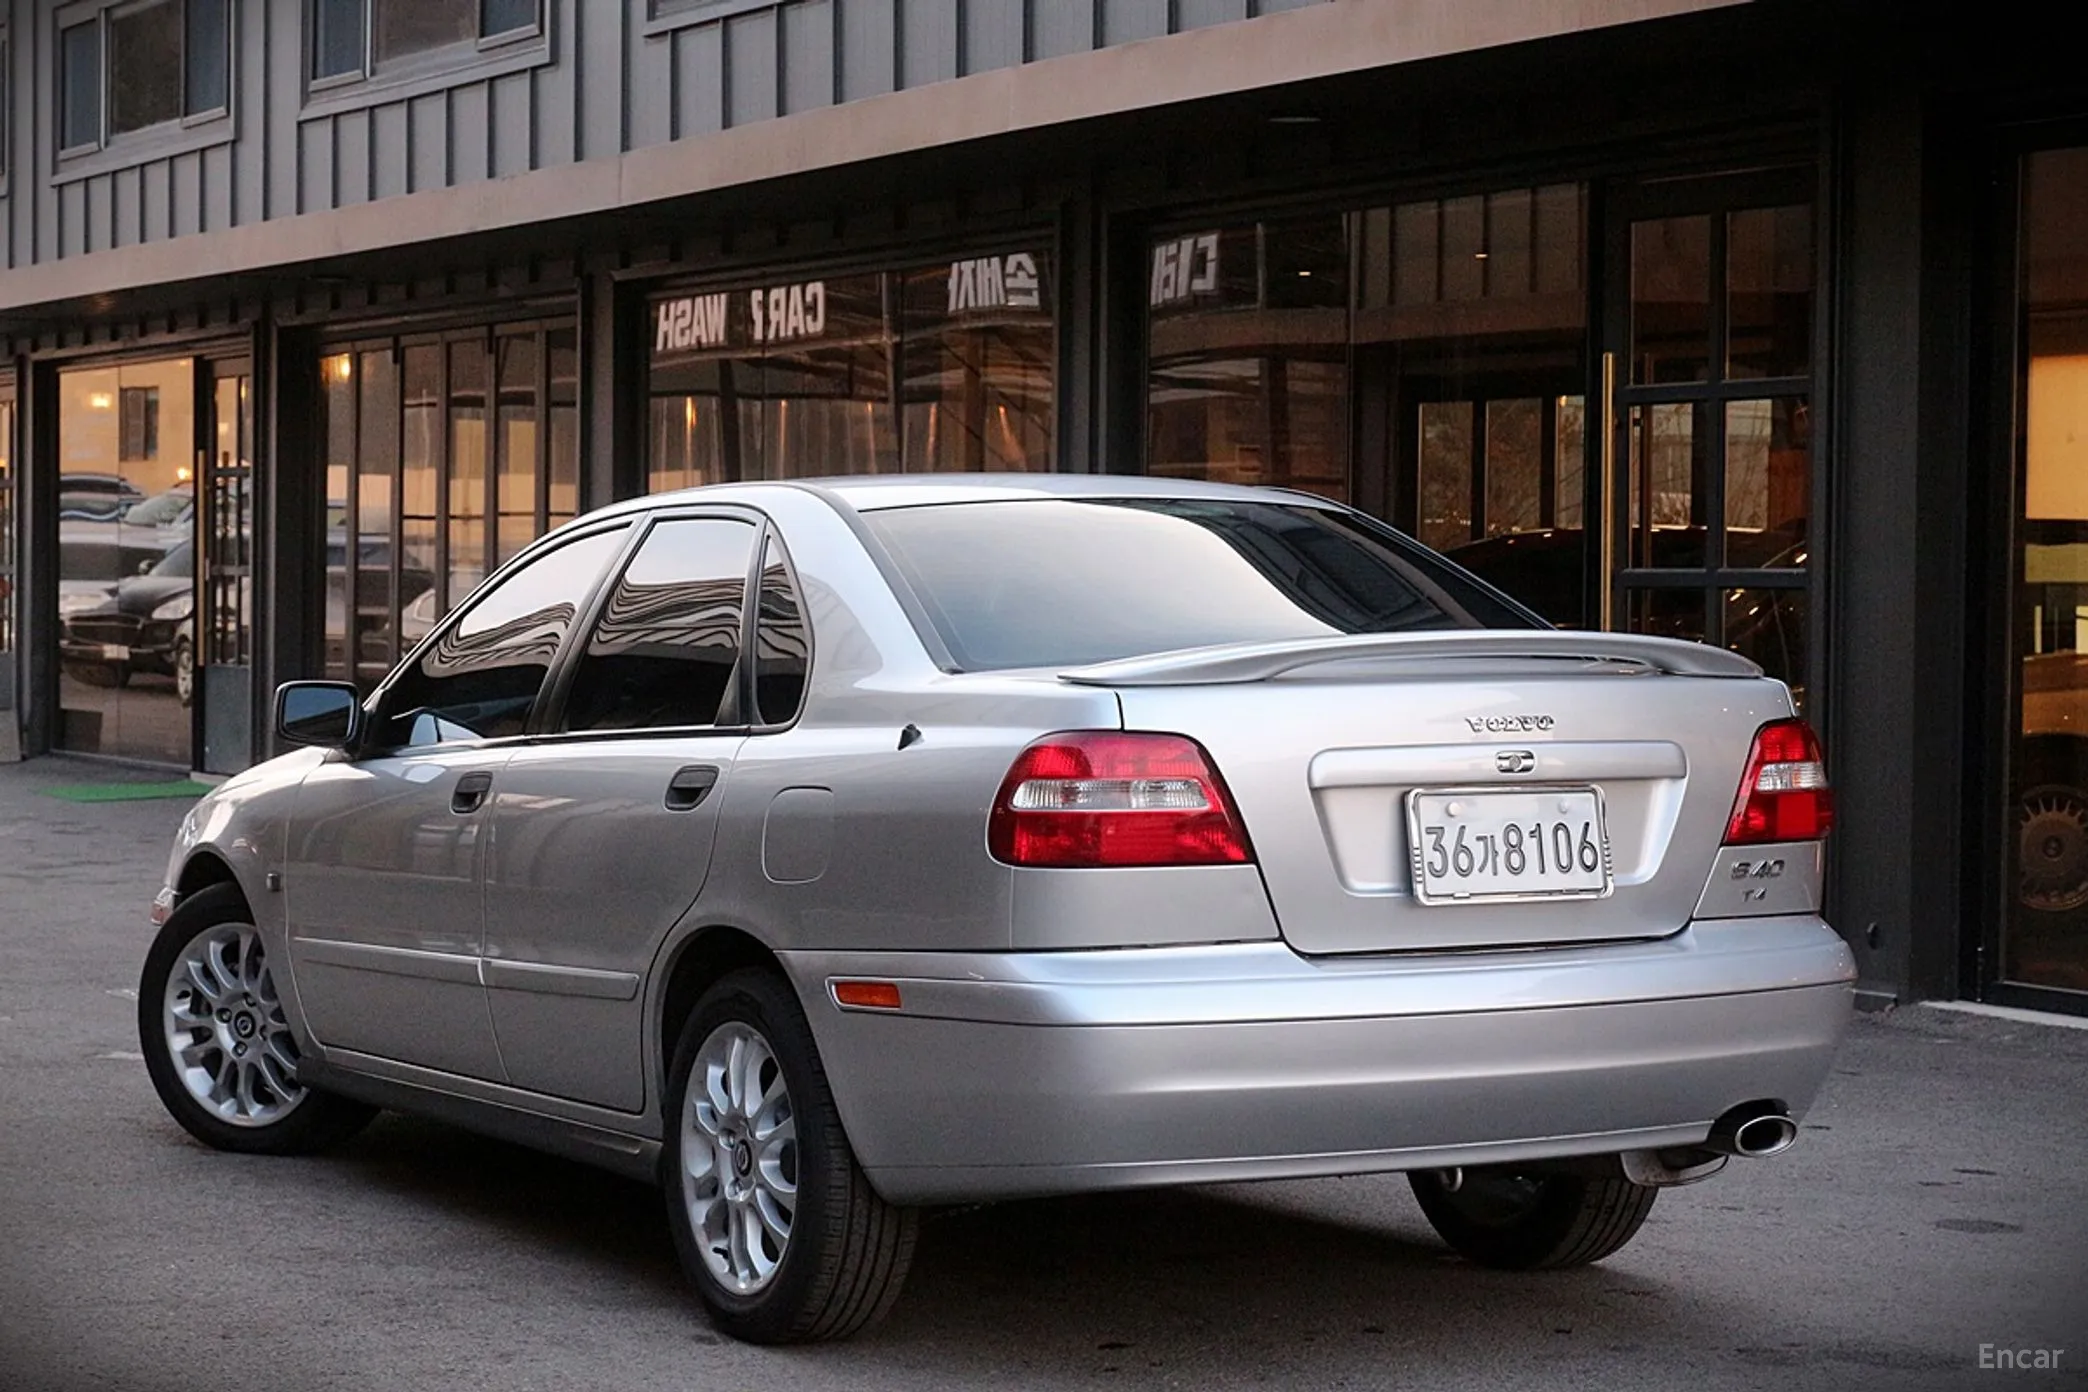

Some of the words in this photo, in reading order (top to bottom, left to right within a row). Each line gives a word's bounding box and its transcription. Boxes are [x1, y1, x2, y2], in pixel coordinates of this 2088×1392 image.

[1465, 715, 1554, 733] VOLVO
[1425, 822, 1599, 878] 36가8106
[1731, 859, 1785, 880] S40
